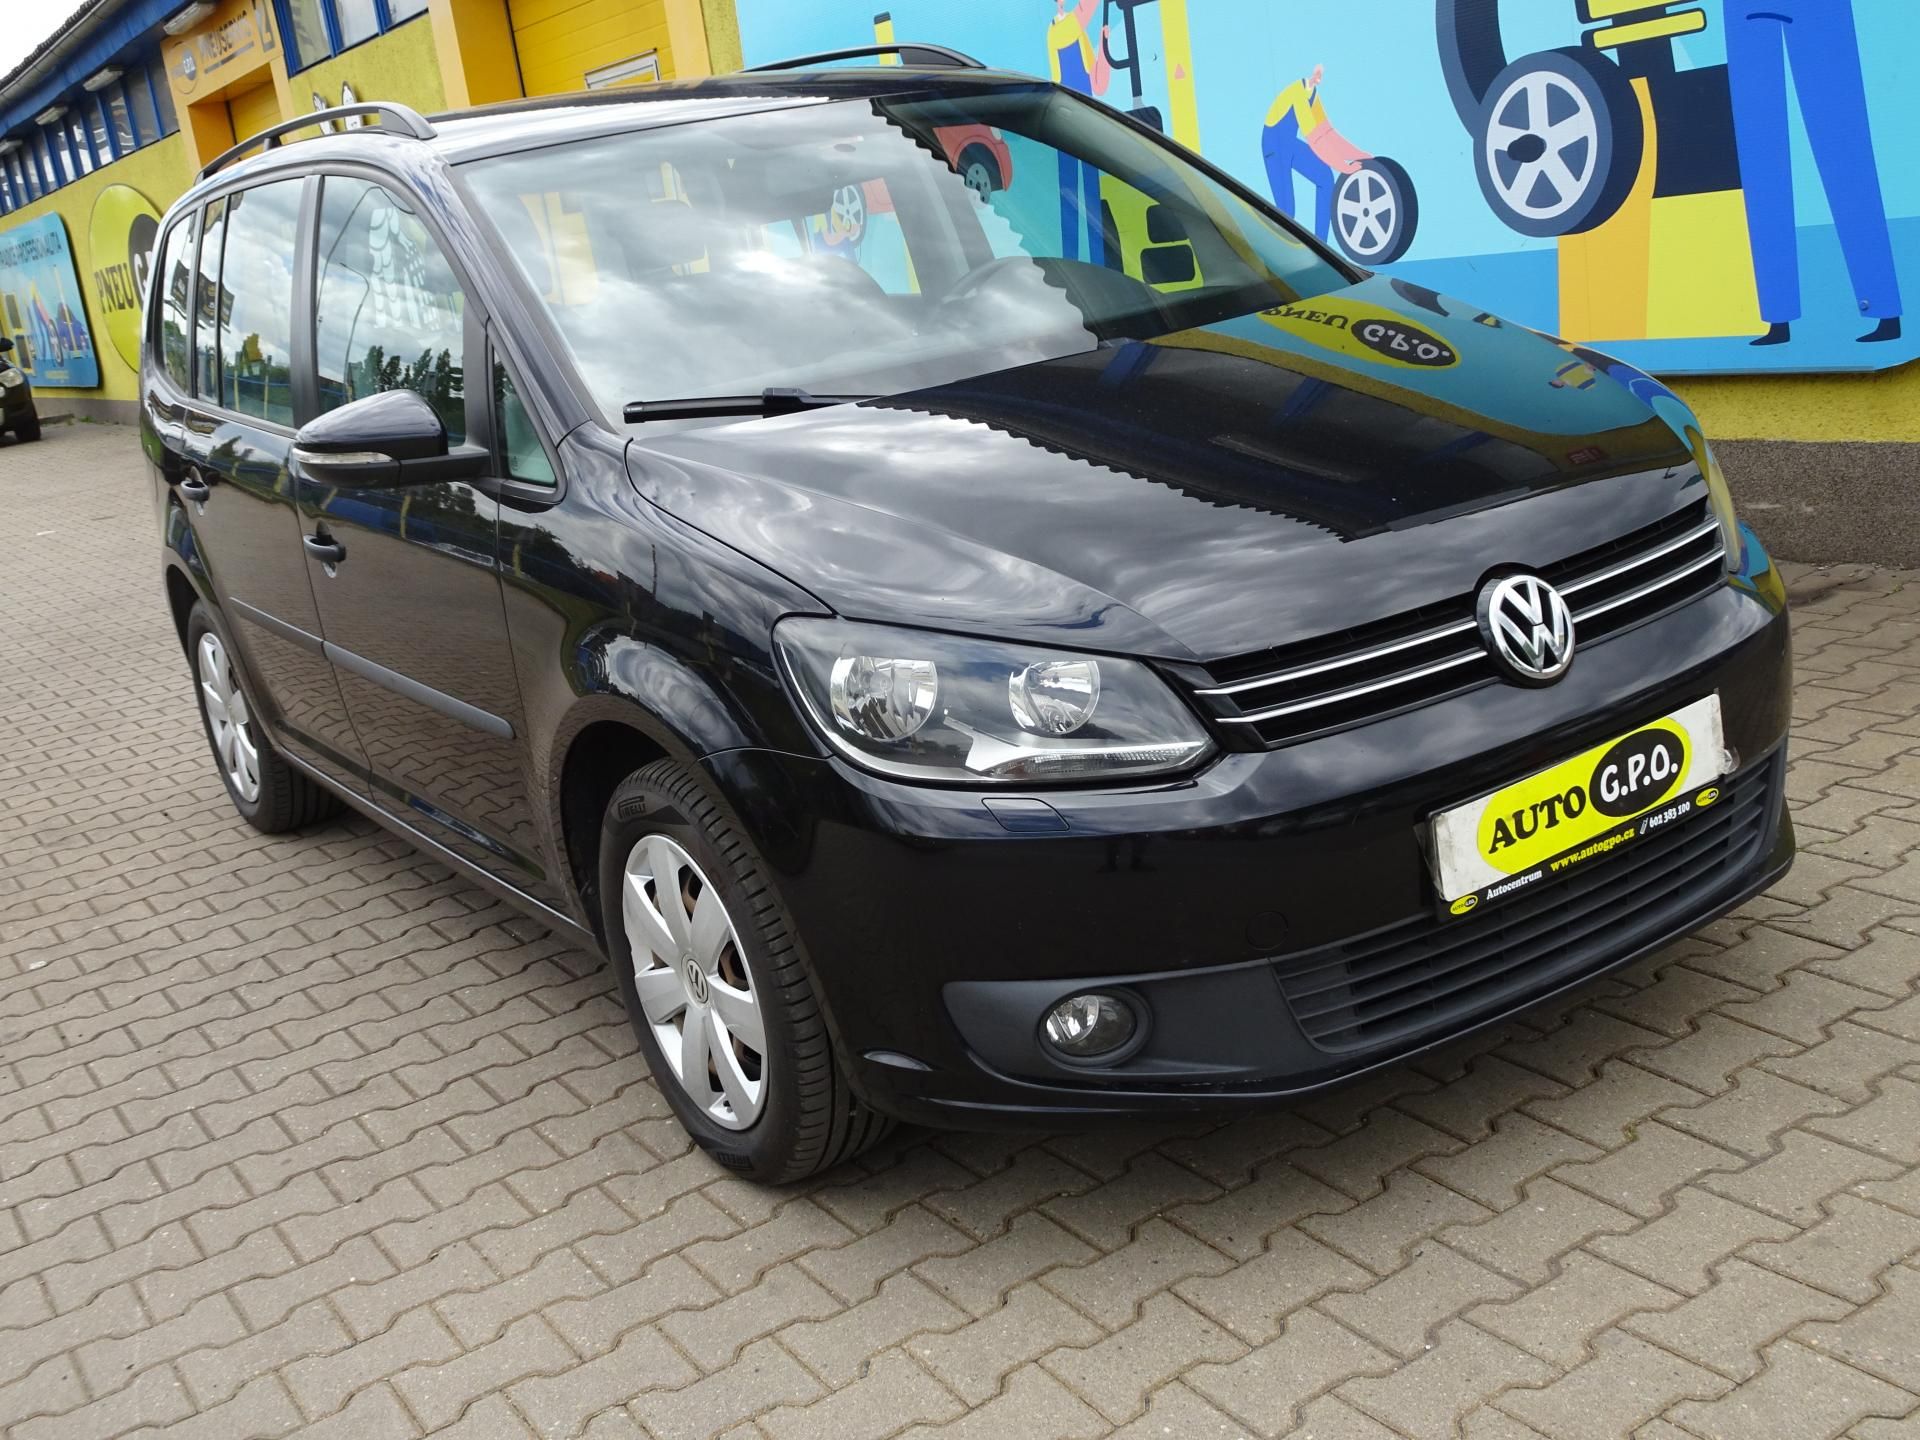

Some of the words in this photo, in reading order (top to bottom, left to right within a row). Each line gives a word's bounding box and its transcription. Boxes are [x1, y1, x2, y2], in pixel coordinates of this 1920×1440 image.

[94, 262, 134, 314] PNEU
[1488, 786, 1587, 854] AUTO
[1600, 744, 1679, 803] G.P.O.
[1486, 870, 1543, 900] Autocentrum
[1550, 828, 1635, 872] www.autogpo.cz
[1649, 814, 1663, 828] 602
[1663, 808, 1677, 823] 383
[1677, 801, 1691, 815] 100
